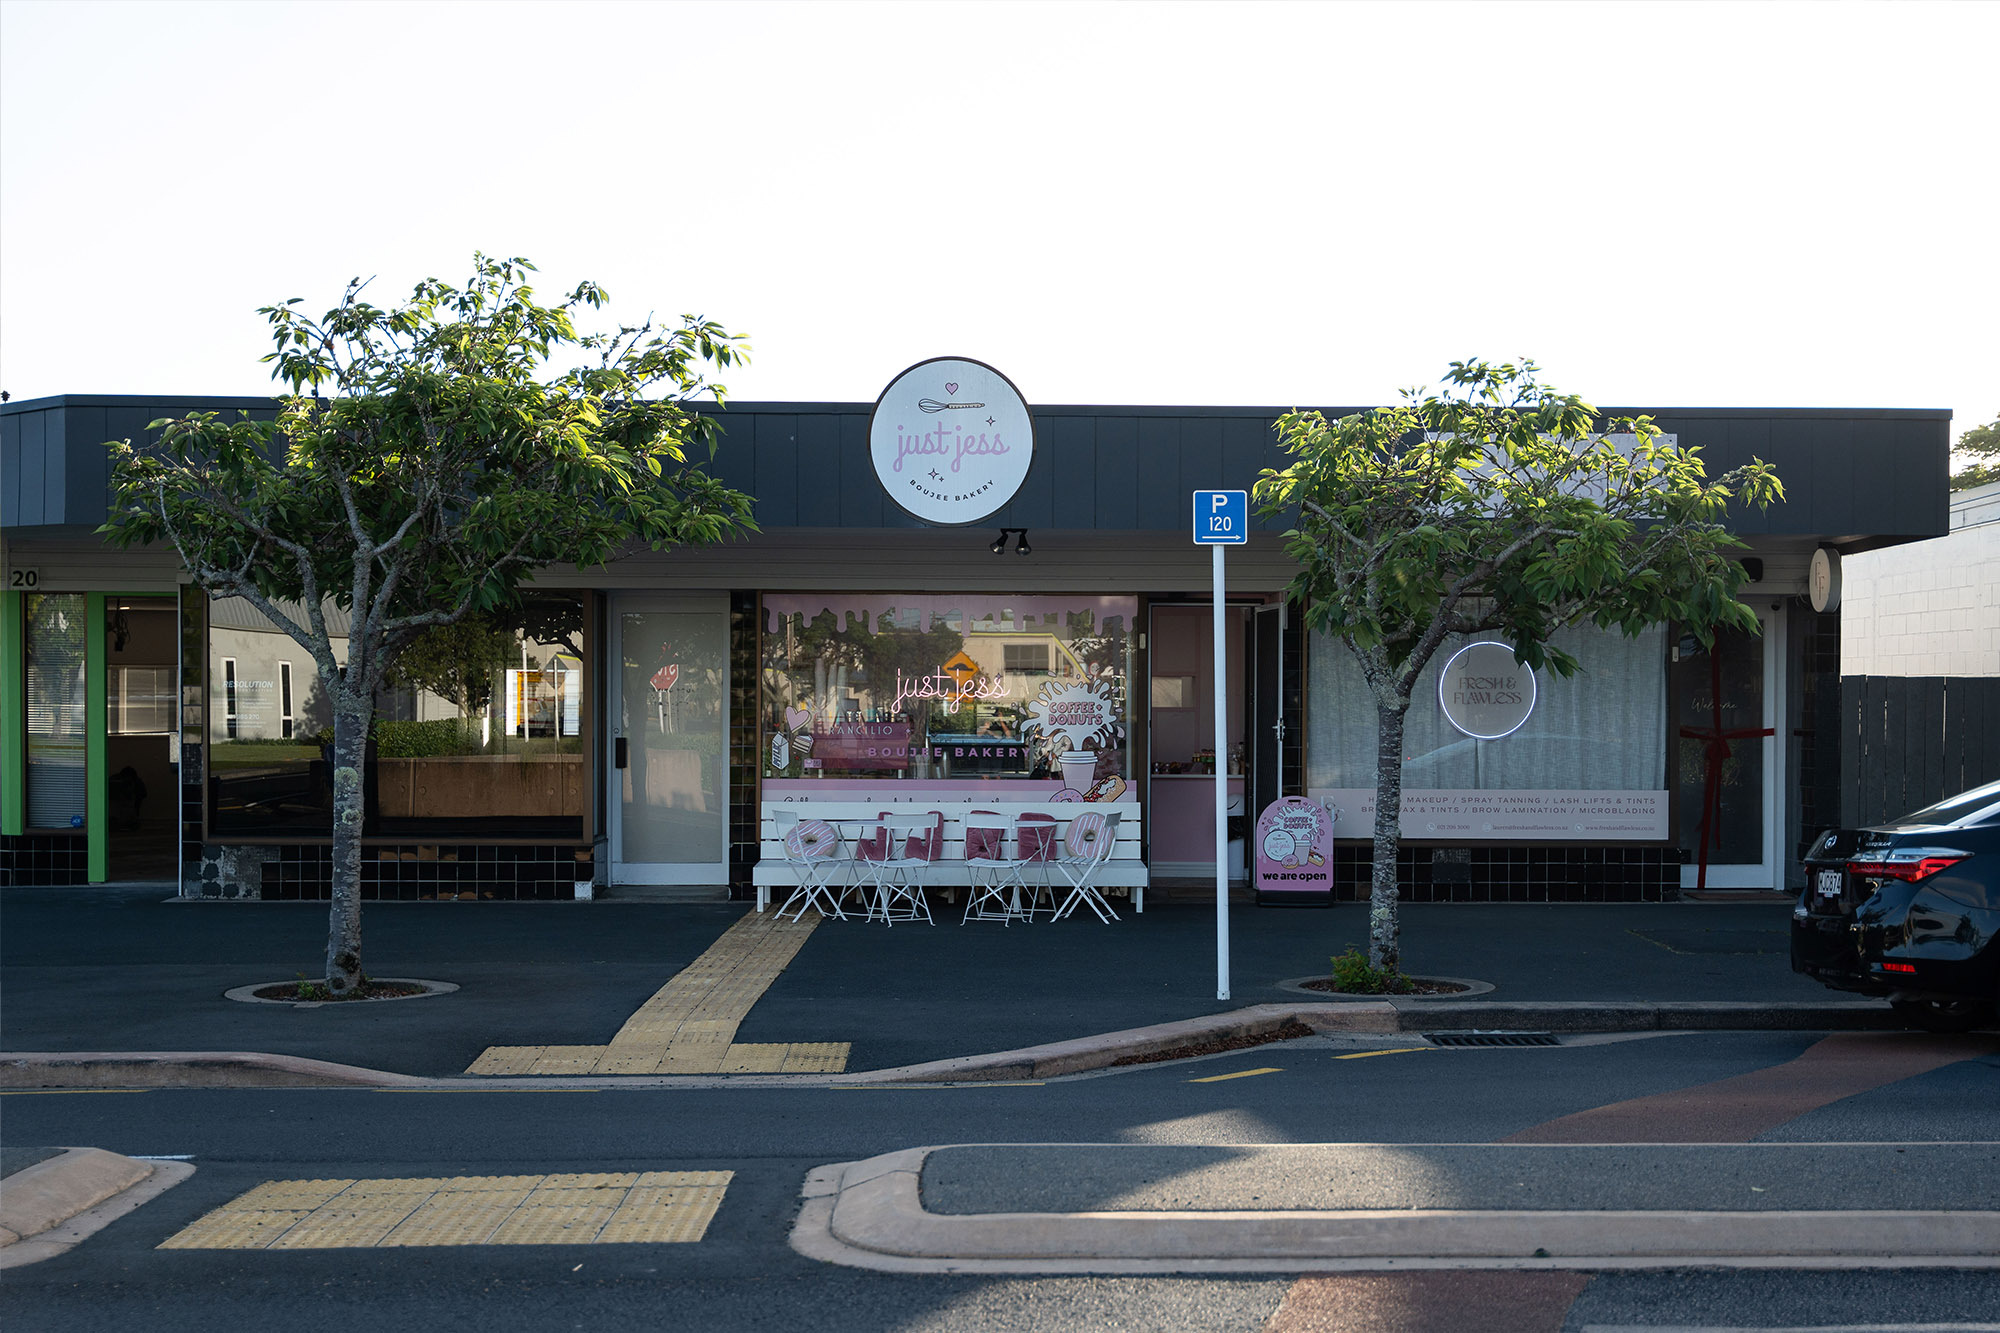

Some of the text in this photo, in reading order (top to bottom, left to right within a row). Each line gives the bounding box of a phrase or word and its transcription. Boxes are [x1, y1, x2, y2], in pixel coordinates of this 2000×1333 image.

[893, 421, 1011, 473] just jess
[910, 480, 994, 501] BOUJEE BAKERY
[1212, 494, 1228, 513] P
[1209, 516, 1231, 531] 120
[12, 571, 37, 586] 20
[891, 665, 1011, 714] just jess
[1048, 702, 1095, 713] COFFEE
[1048, 714, 1103, 725] DONUTS
[828, 725, 893, 735] RANCILIO
[868, 747, 1031, 758] BOUJEE BAKERY
[1299, 873, 1327, 882] open
